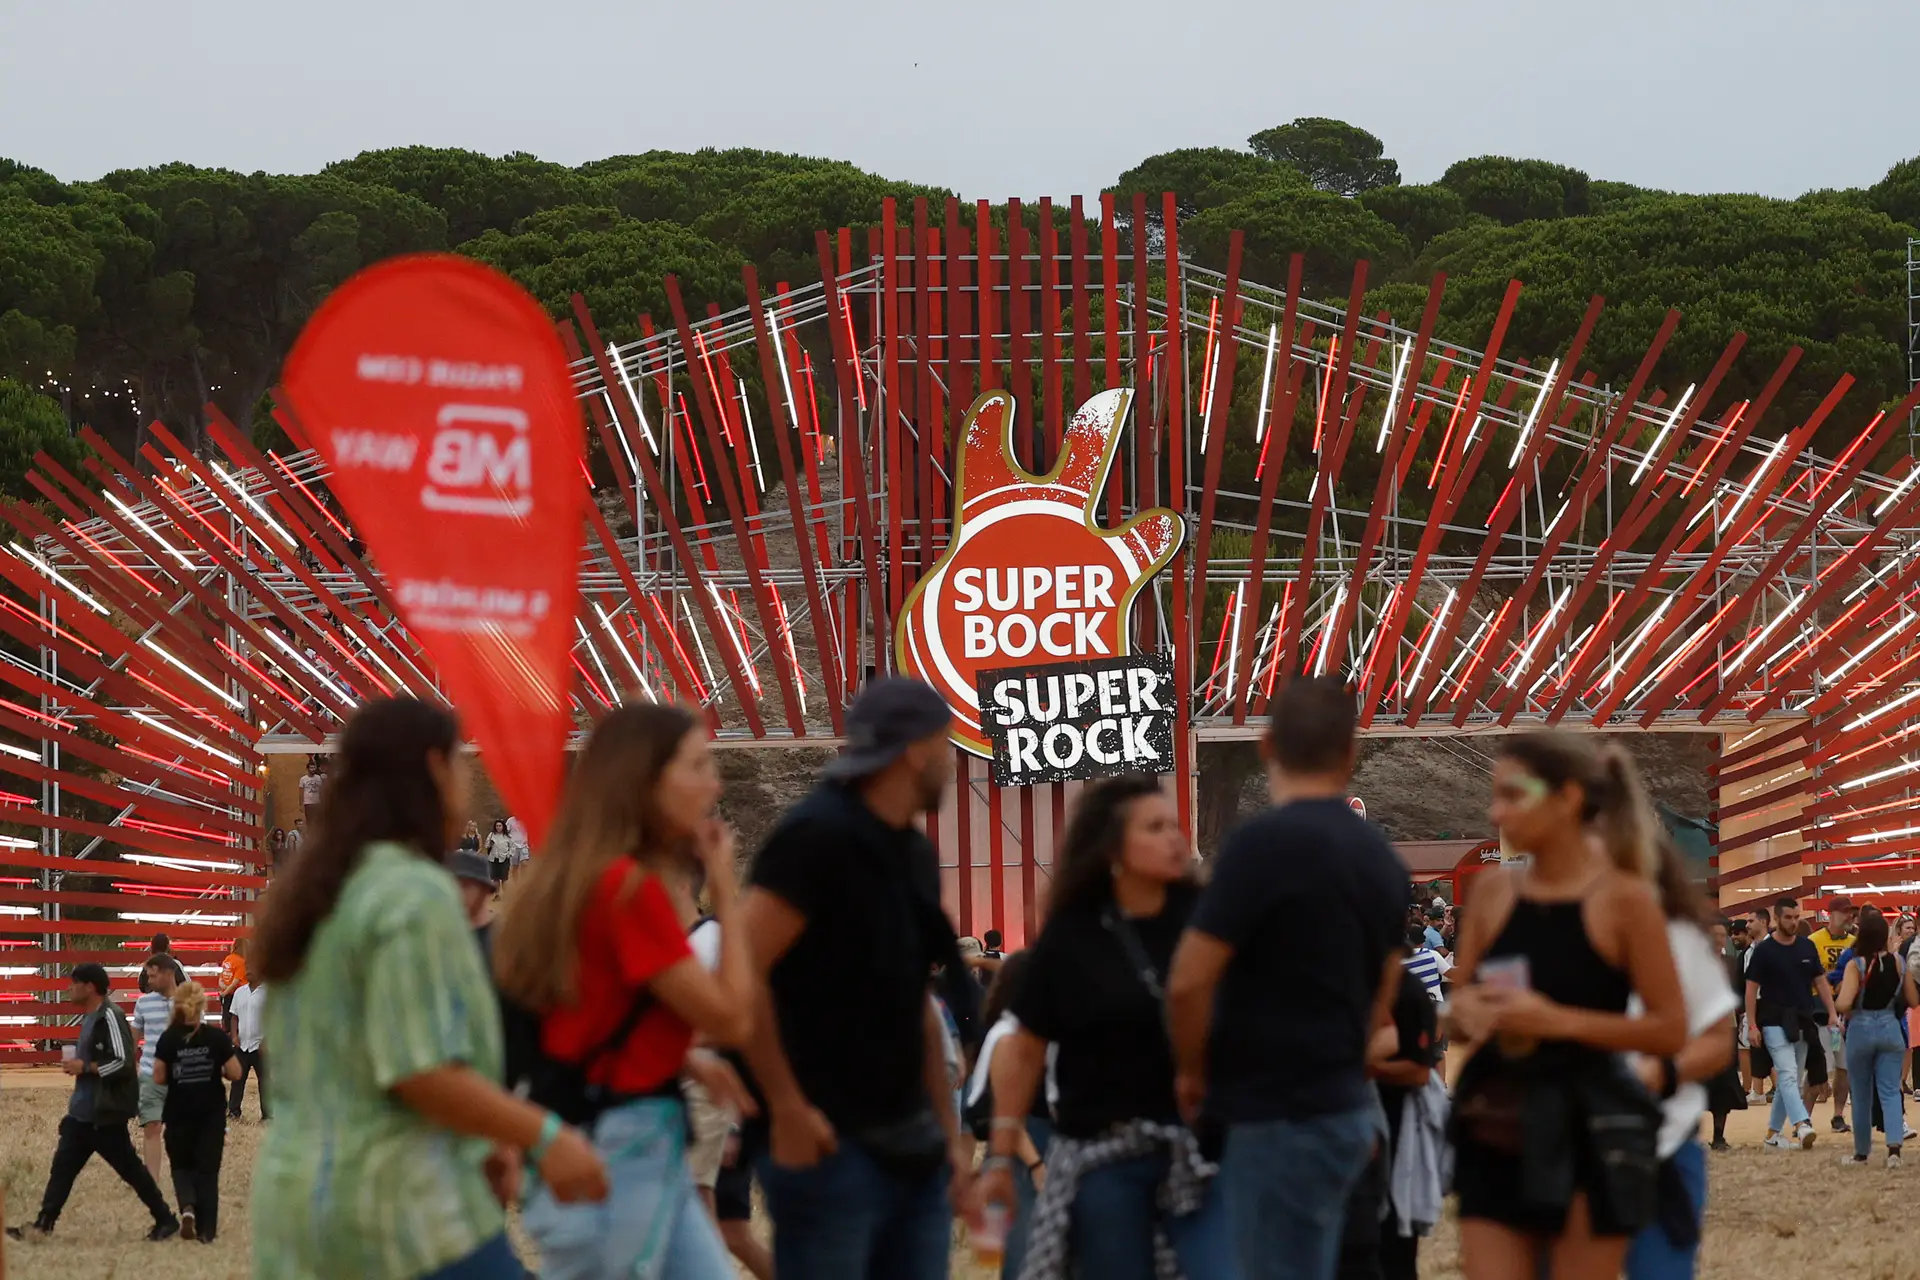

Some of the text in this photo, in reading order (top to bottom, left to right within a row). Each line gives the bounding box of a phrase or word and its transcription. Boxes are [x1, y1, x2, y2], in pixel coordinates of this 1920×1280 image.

[953, 564, 1116, 612] SUPER
[963, 611, 1110, 658] BOCK
[993, 667, 1163, 726] SUPER
[1007, 715, 1159, 773] ROCK
